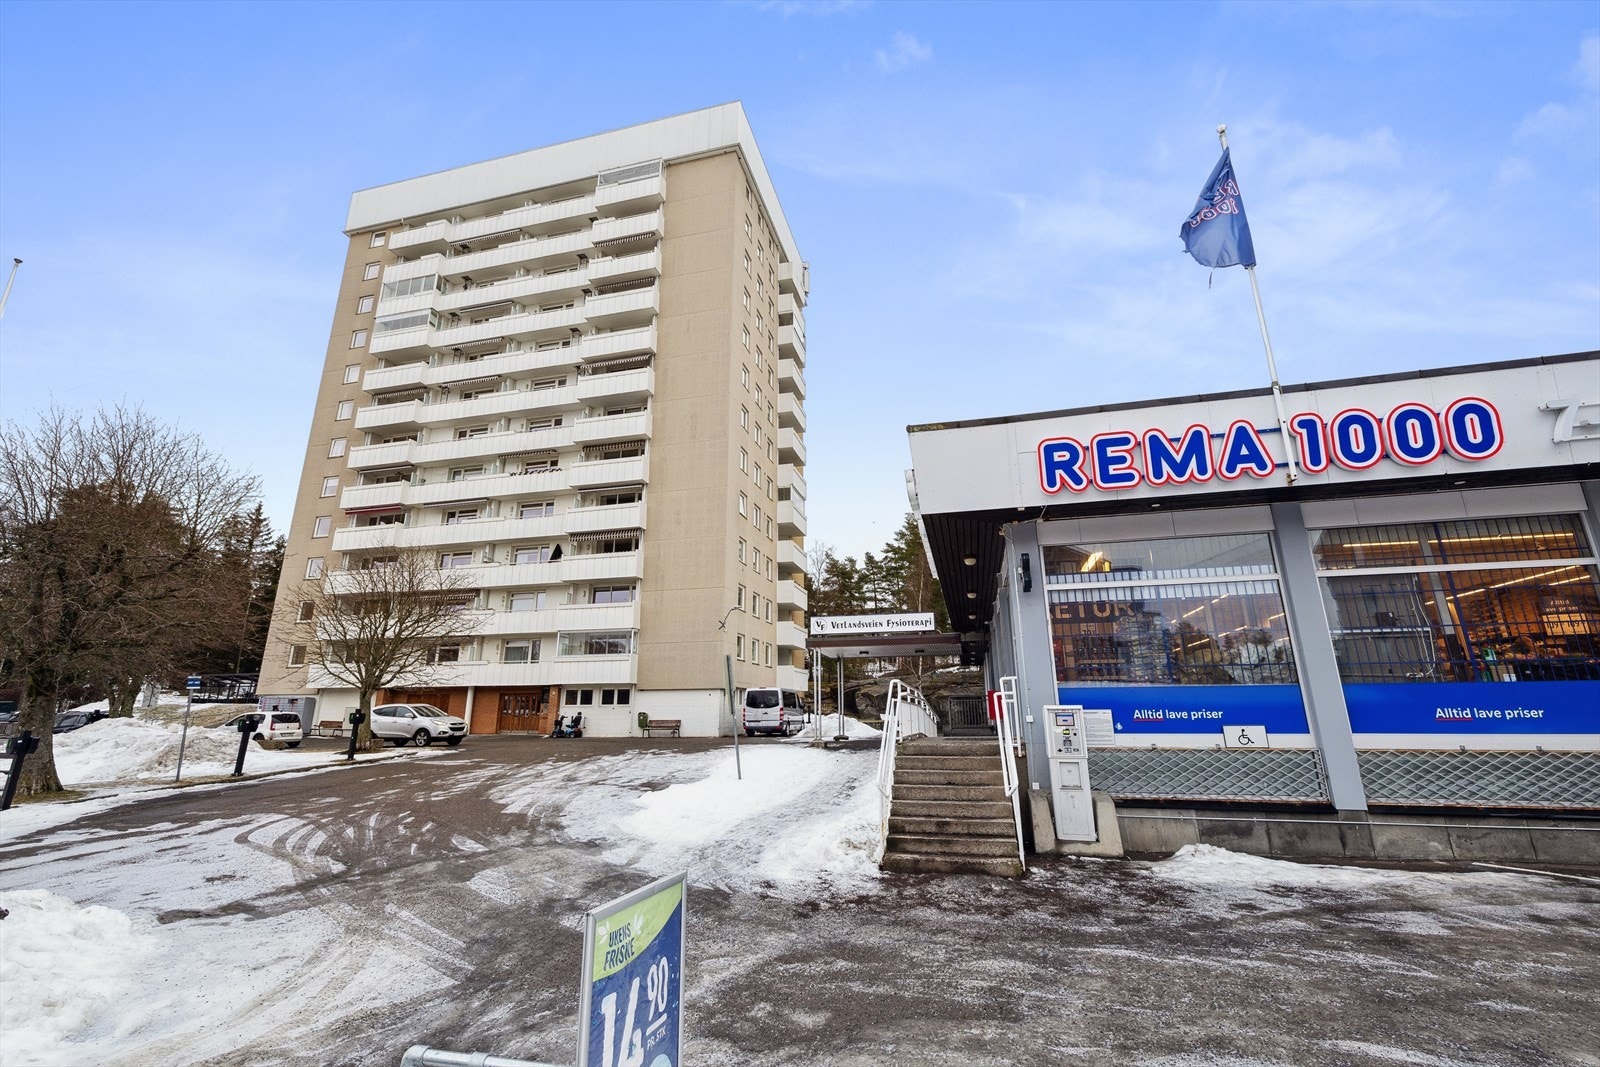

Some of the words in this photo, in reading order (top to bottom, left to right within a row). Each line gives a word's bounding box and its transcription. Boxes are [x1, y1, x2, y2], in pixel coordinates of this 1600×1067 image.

[1036, 423, 1274, 494] REMA
[1289, 396, 1504, 473] 1000
[1133, 709, 1163, 719] Alltid
[1165, 709, 1188, 719] lave
[1190, 709, 1223, 720] priser
[1435, 707, 1472, 718] Alltid
[1473, 707, 1502, 718] lave
[1504, 707, 1544, 720] priser
[608, 922, 632, 948] UKENS
[603, 937, 635, 971] FRISKE
[656, 1026, 666, 1043] STK
